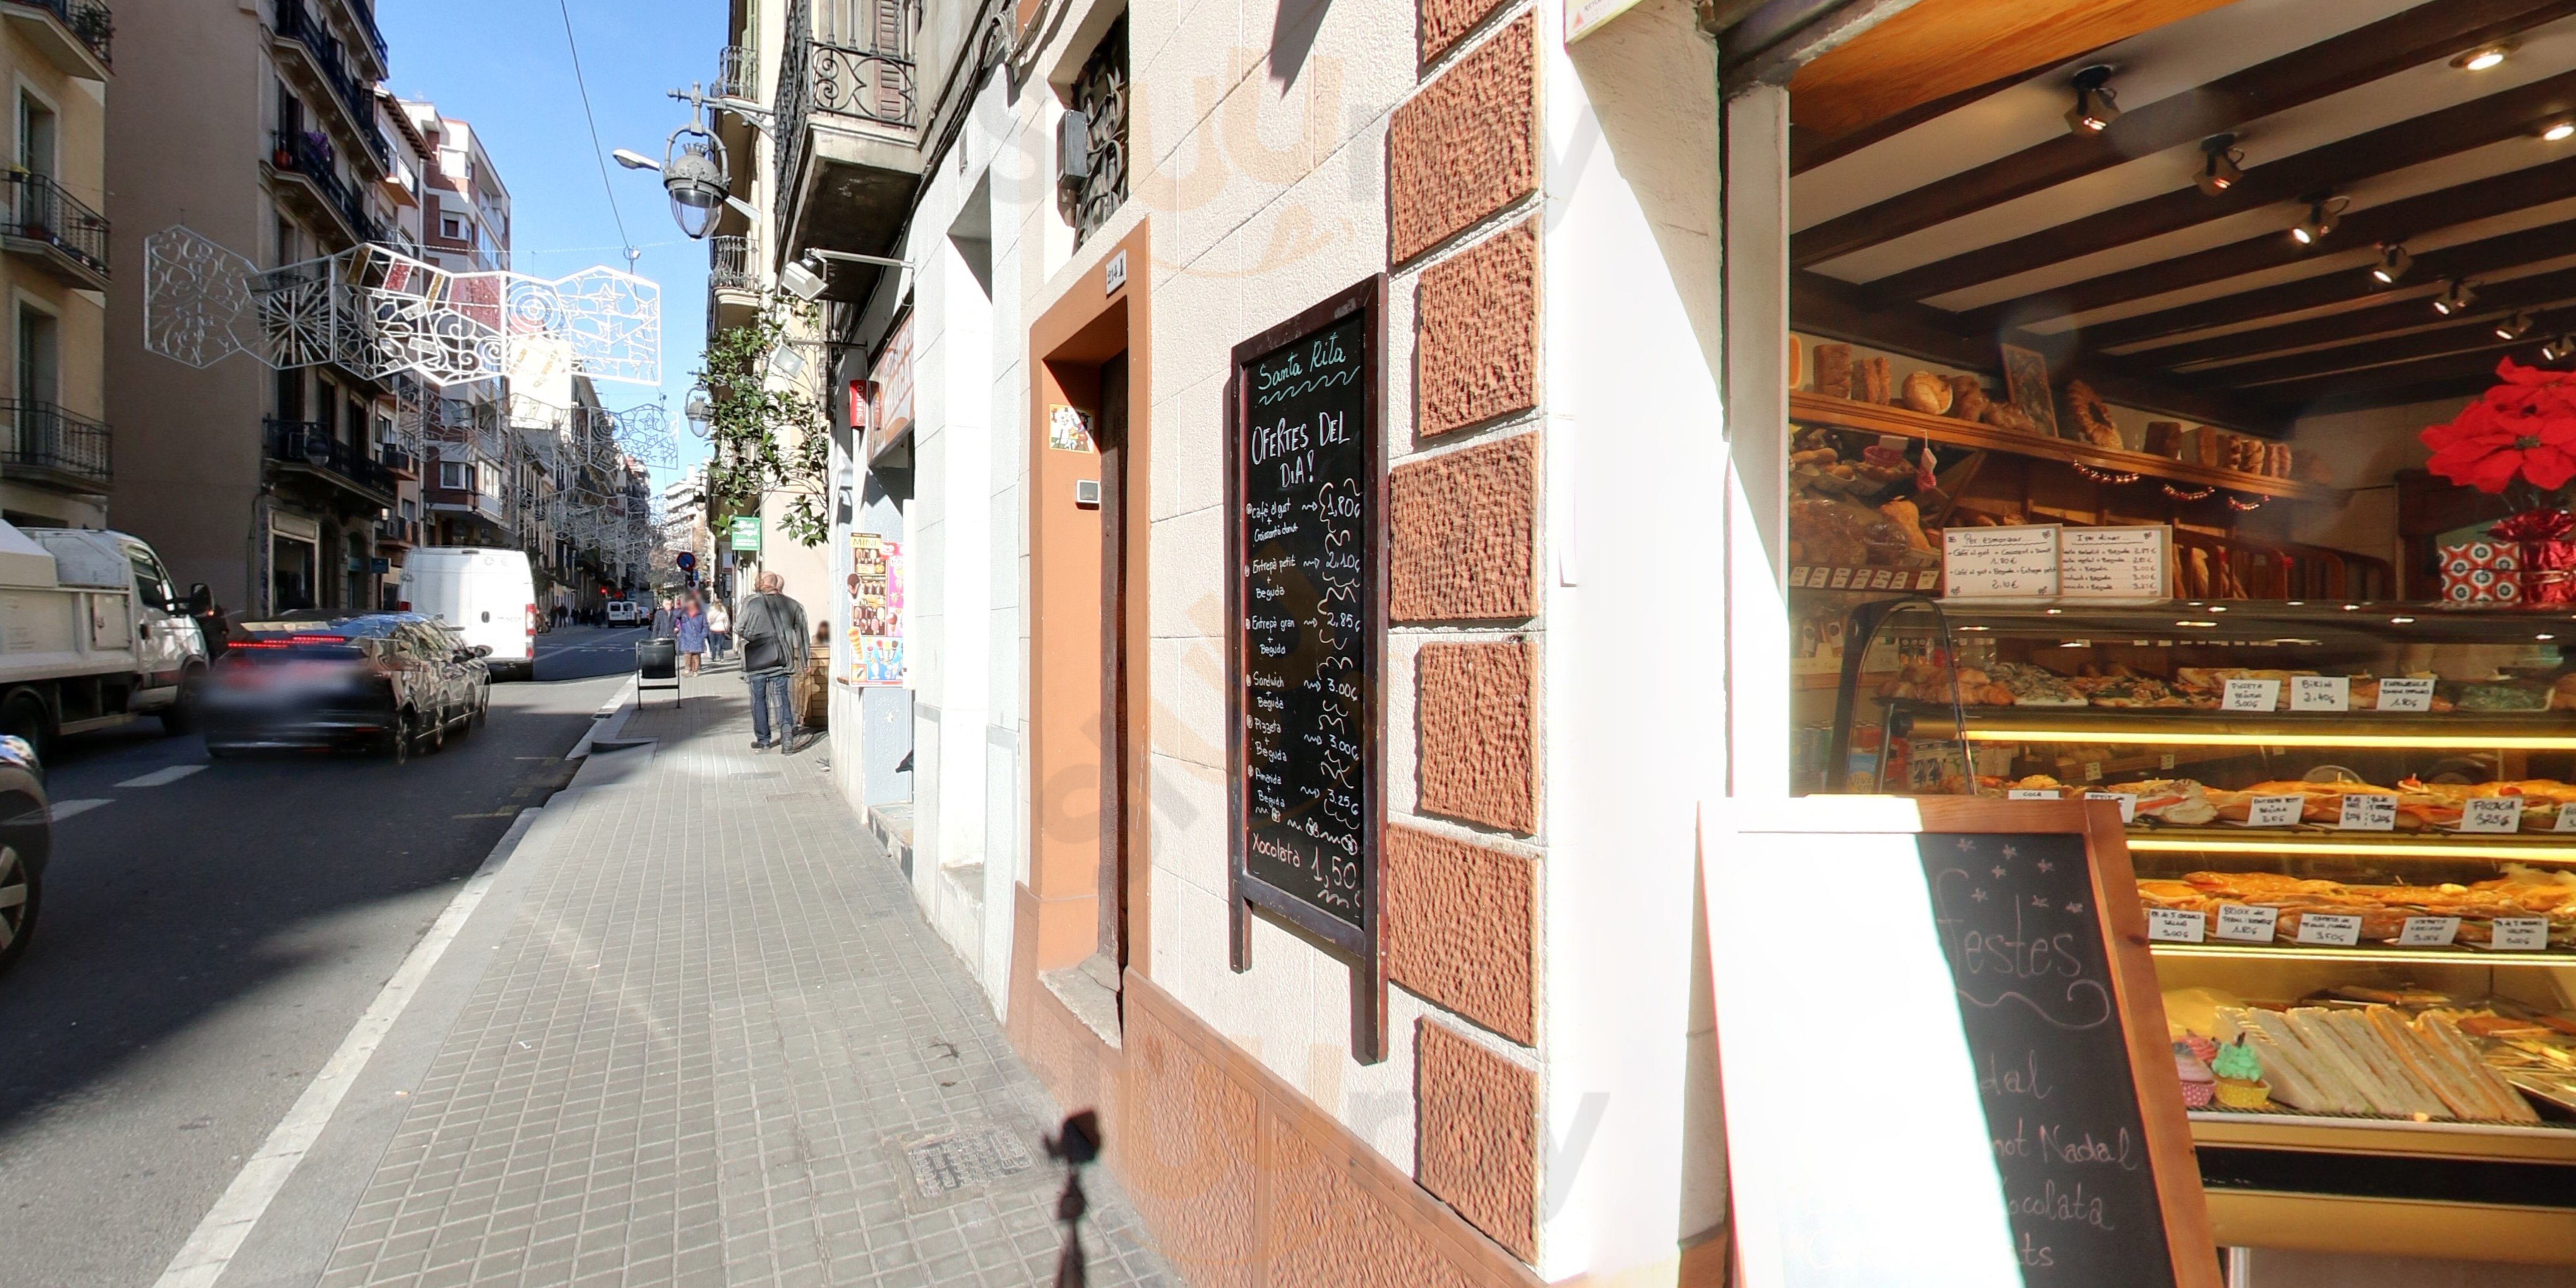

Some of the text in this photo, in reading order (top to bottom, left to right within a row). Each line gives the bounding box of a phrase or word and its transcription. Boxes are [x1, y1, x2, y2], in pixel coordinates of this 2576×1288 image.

[1258, 332, 1346, 390] Santa Rita
[1252, 411, 1350, 464] OFERTES DEL
[1279, 554, 1296, 573] petit
[1255, 585, 1285, 601] Beguda
[1280, 619, 1295, 632] gran
[1259, 643, 1286, 657] Beguda
[1253, 671, 1285, 688] Sandwich
[1257, 697, 1284, 712] Beguda
[1254, 718, 1281, 734] Pizzeta
[1255, 741, 1287, 763] Beguda
[1257, 790, 1285, 808] Beguda
[1252, 832, 1357, 889] Xocolata 1,50
[2039, 1124, 2138, 1171] Nadal
